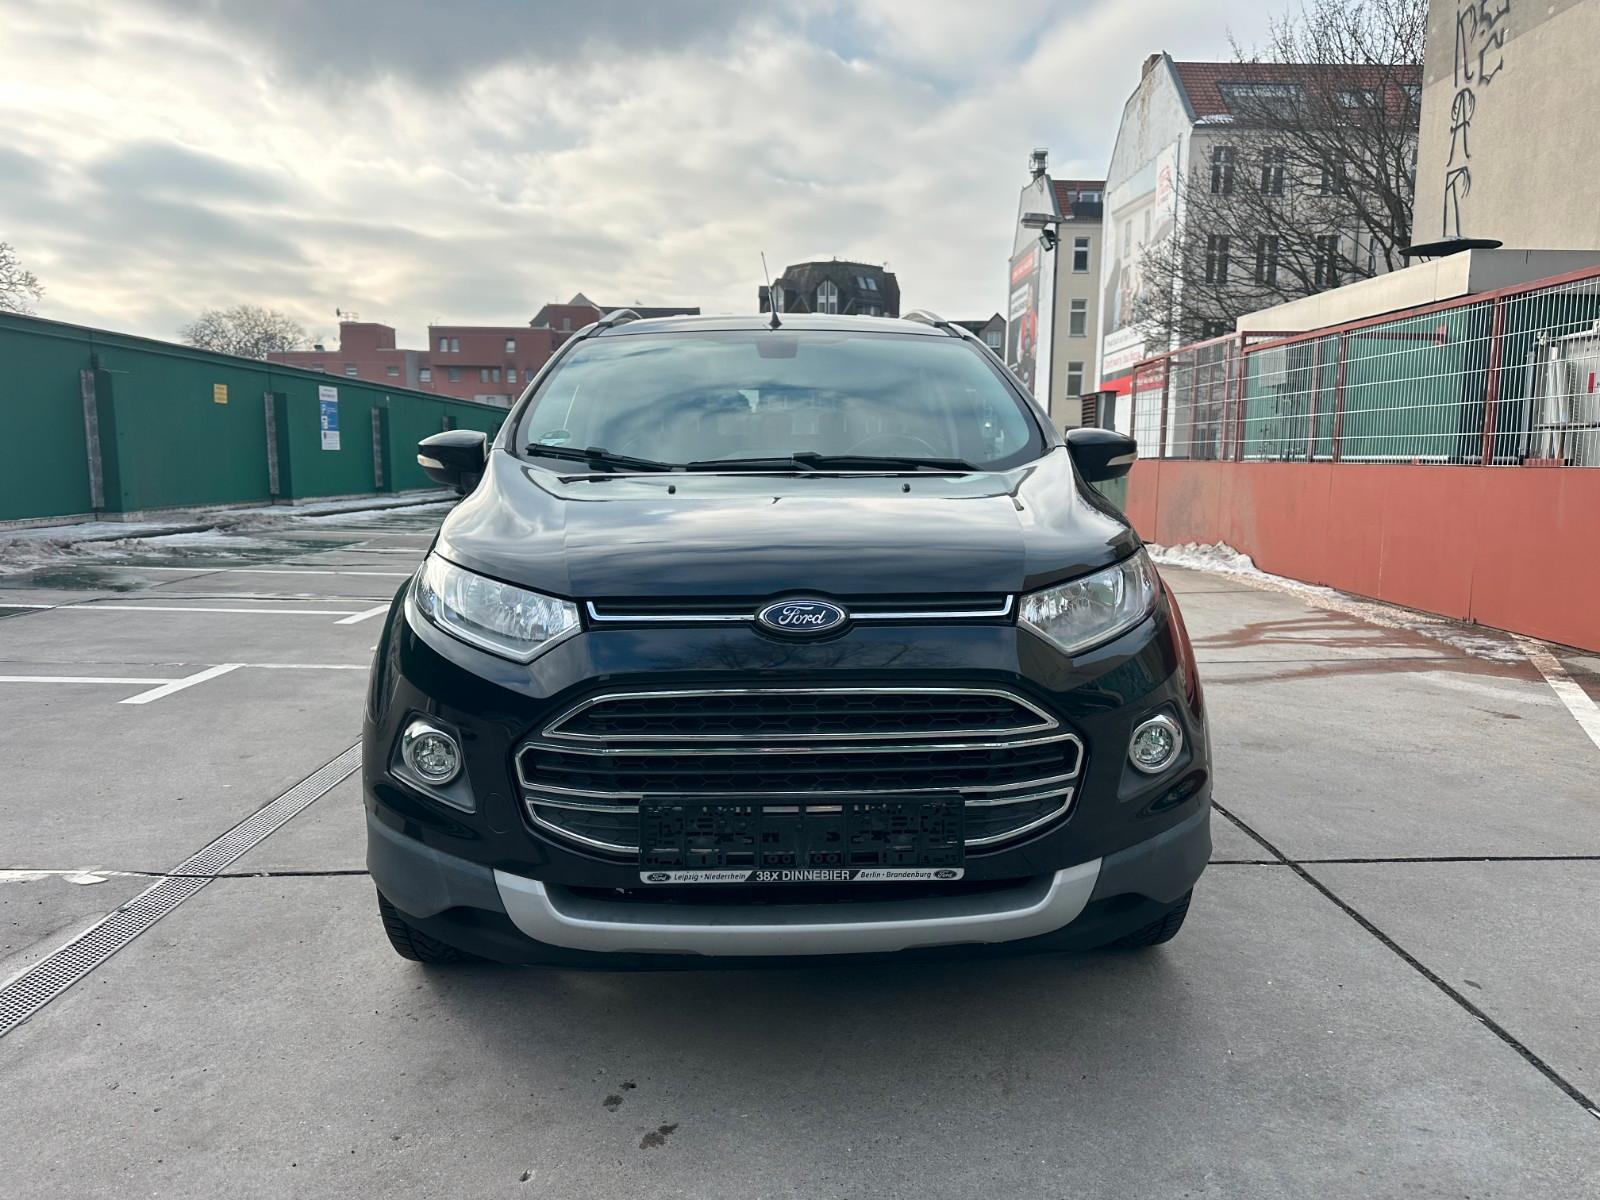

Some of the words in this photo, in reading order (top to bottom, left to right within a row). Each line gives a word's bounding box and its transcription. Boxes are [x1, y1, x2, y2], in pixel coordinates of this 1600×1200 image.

[778, 605, 827, 625] Ford
[674, 873, 699, 882] Leipzig
[704, 872, 746, 880] Niederrhein
[782, 870, 850, 881] DINNEBIER
[860, 871, 881, 879] Berlin
[886, 871, 932, 879] Brandenburg
